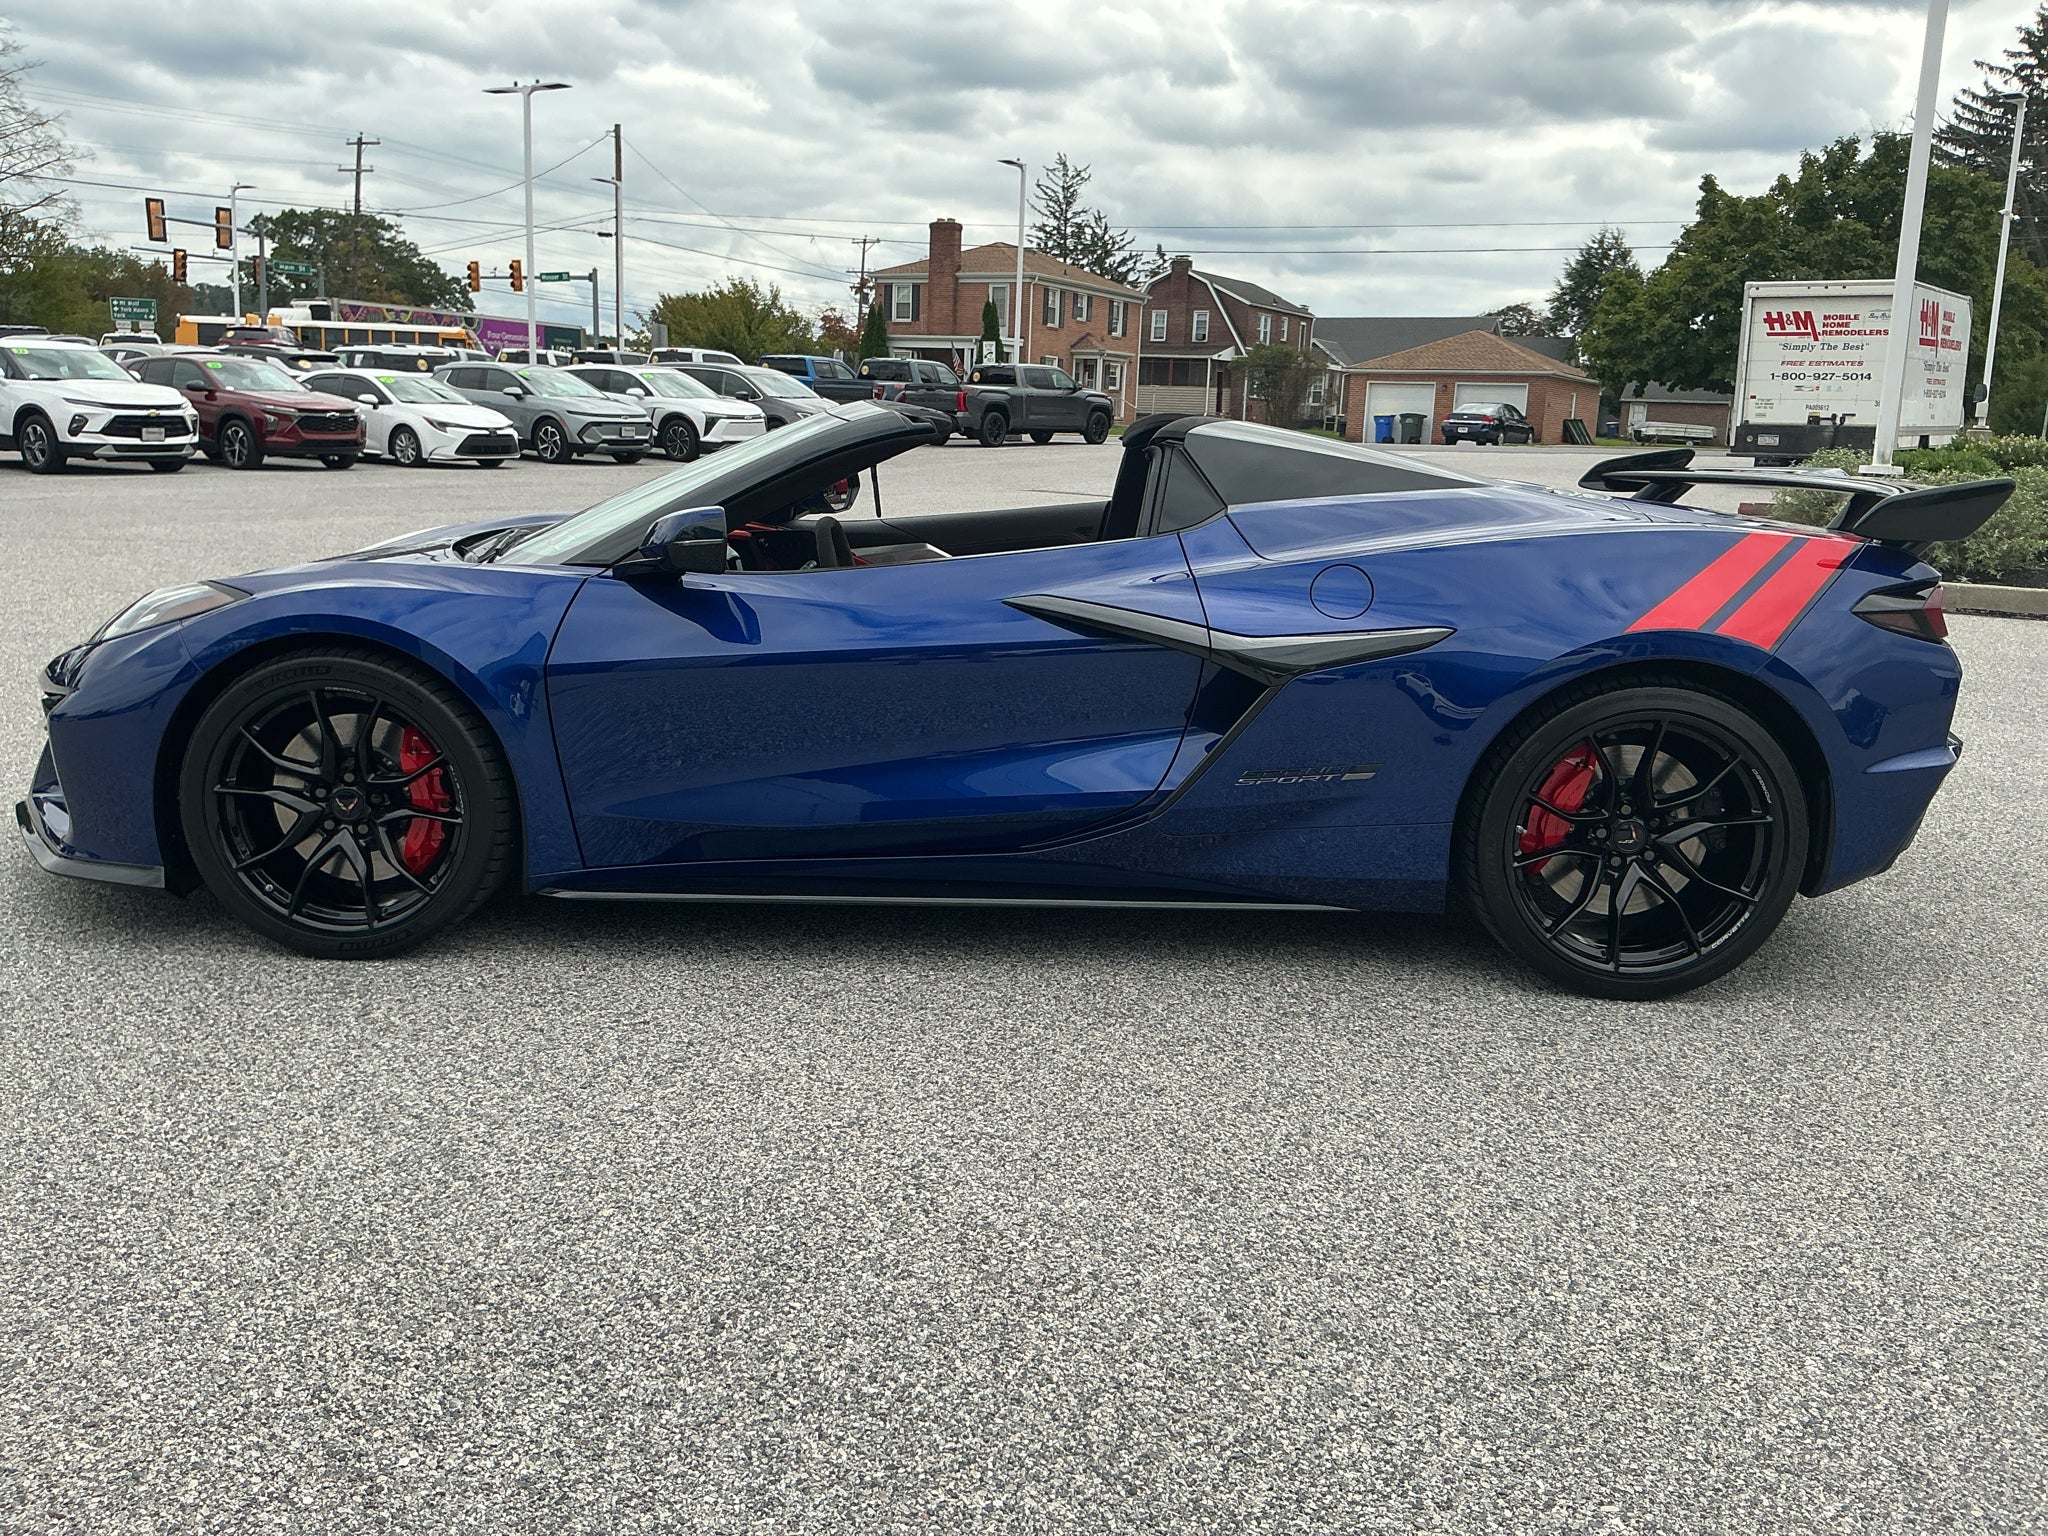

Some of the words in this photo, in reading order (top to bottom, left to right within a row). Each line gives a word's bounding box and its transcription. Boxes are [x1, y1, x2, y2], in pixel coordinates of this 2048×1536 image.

[1763, 311, 1820, 341] H&M
[487, 330, 501, 339] Four
[1820, 343, 1838, 351] The
[1770, 372, 1872, 381] 1-800-927-5014
[1235, 774, 1342, 786] SPORT
[1751, 768, 1773, 804] FORGED
[1711, 911, 1750, 949] CORVETTE
